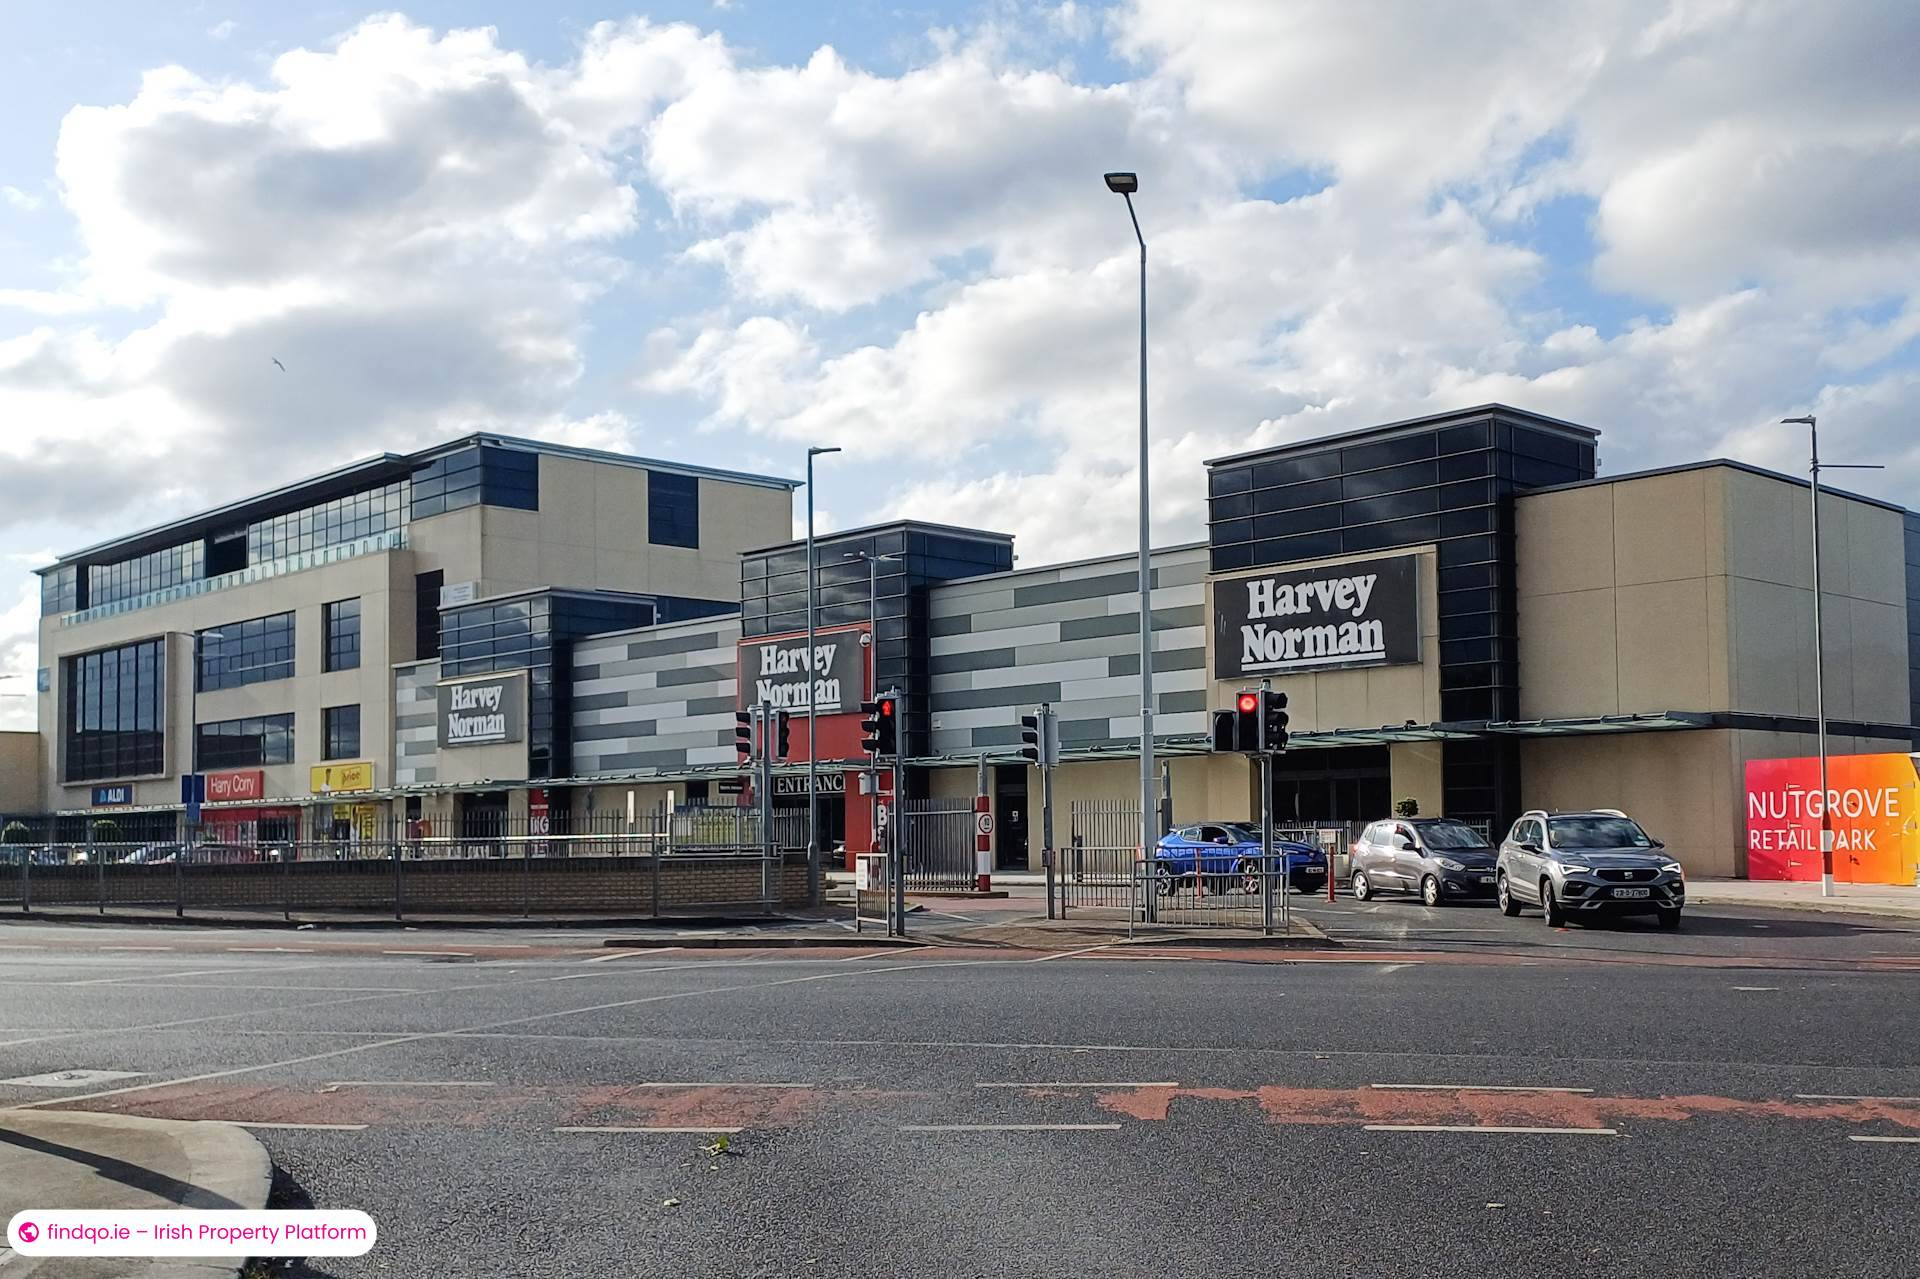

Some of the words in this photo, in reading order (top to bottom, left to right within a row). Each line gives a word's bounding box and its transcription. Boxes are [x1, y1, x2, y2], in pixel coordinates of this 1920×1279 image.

[1246, 573, 1377, 620] Harvey
[1240, 619, 1385, 663] Norman
[759, 644, 837, 676] Harvey
[450, 685, 503, 712] Harvey
[755, 678, 841, 707] Norman
[447, 712, 506, 738] Norman
[107, 788, 125, 803] ALDI
[211, 777, 232, 798] Harry
[232, 775, 255, 795] Corry
[1748, 787, 1900, 819] NUTGROVE
[1750, 829, 1817, 851] RETAIL
